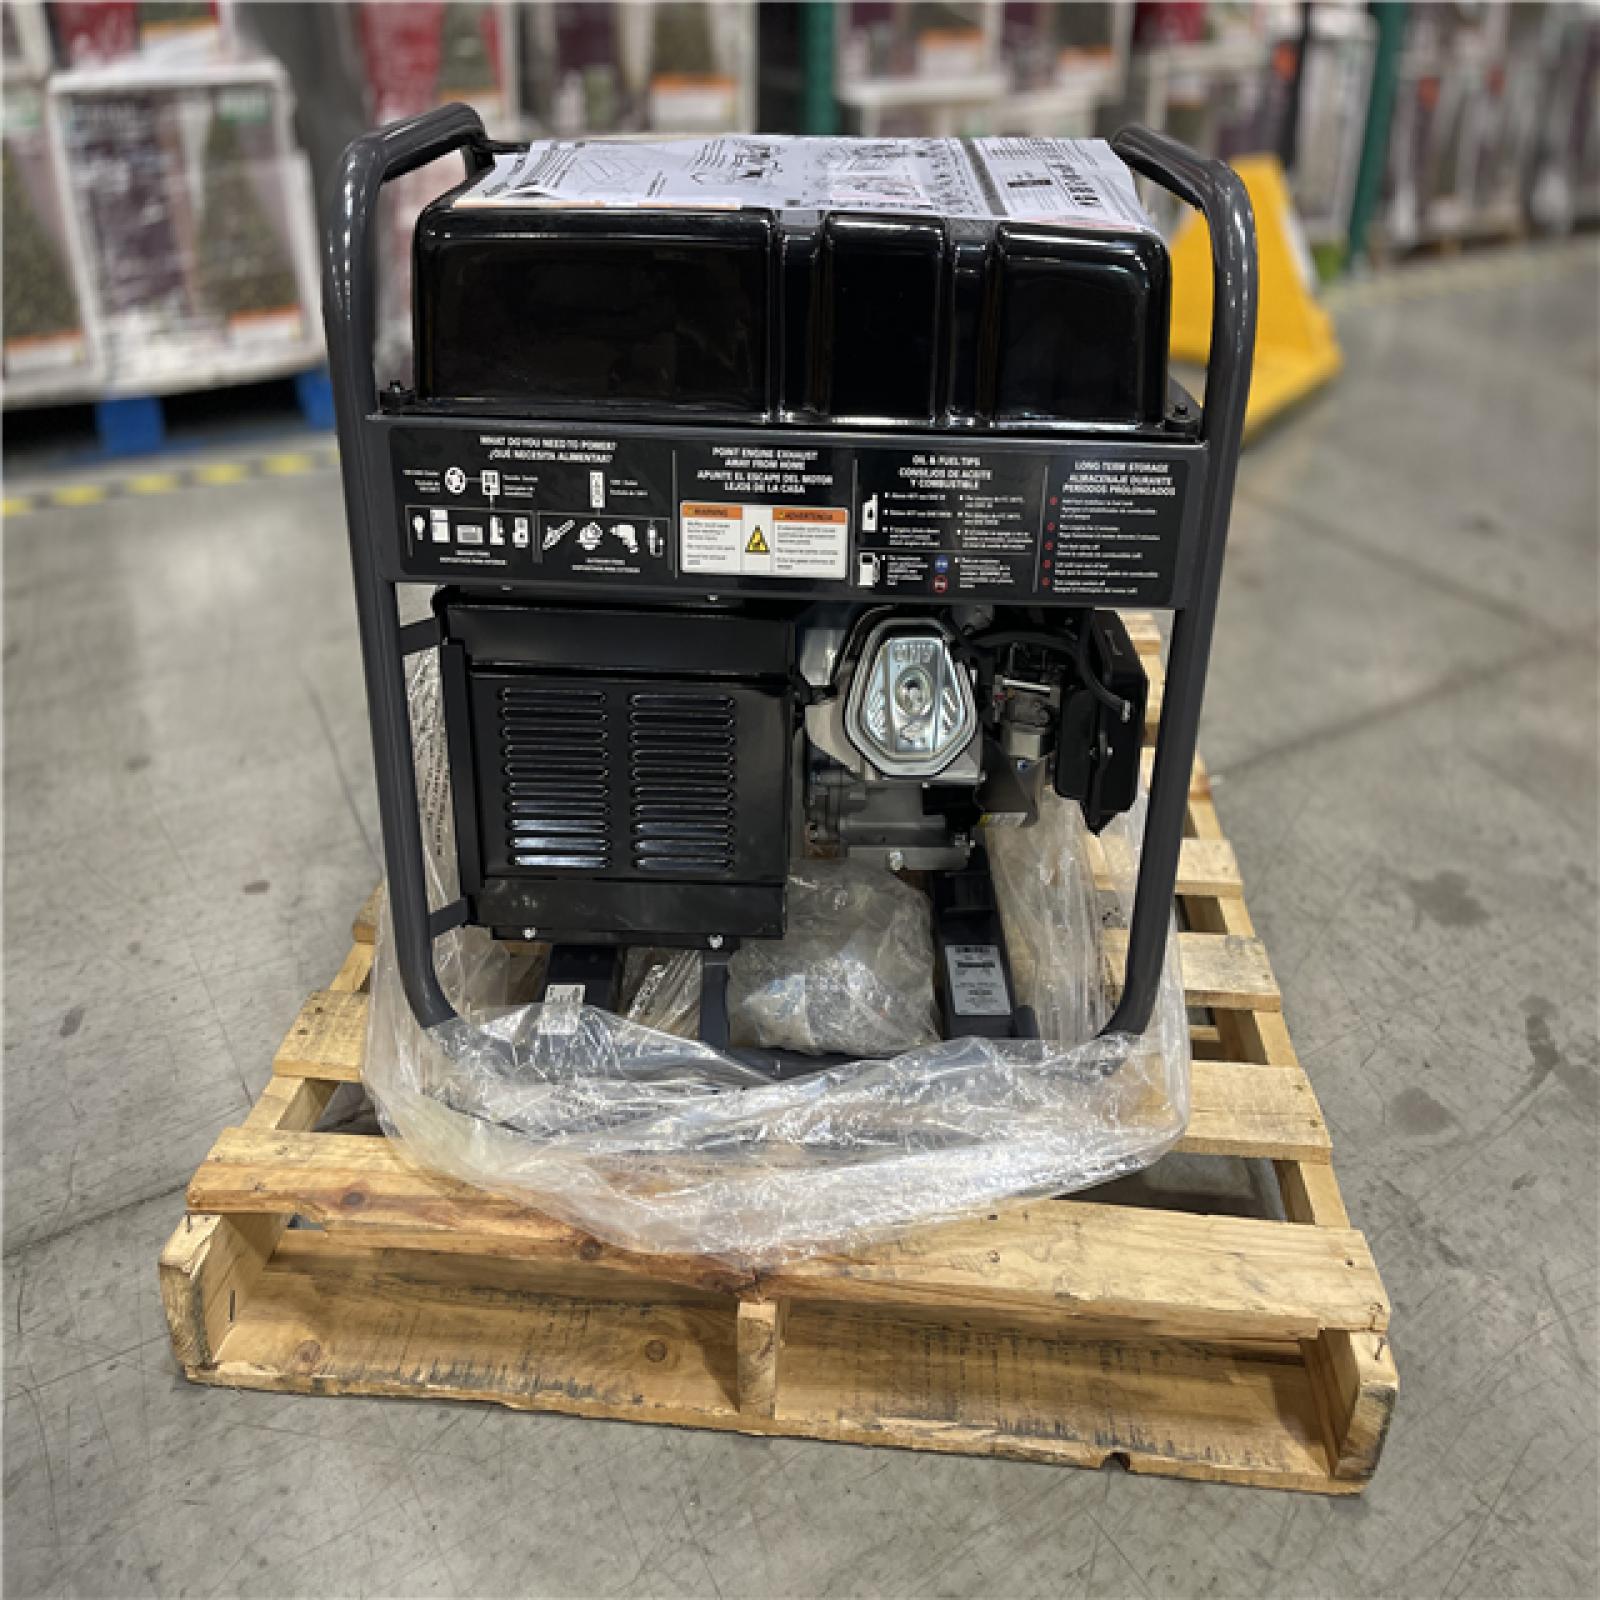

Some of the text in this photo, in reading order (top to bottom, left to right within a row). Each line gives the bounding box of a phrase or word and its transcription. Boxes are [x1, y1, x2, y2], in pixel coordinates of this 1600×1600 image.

[712, 447, 818, 461] POINT ENGINE EXHAUST
[725, 459, 751, 469] AWAY
[752, 459, 778, 470] FROM
[912, 454, 926, 465] OIL
[939, 456, 960, 466] FUEL
[961, 456, 980, 467] TIPS
[1074, 461, 1101, 471] LONG
[1102, 461, 1126, 471] TERM
[735, 472, 745, 481] EL
[747, 472, 781, 482] ESCAPE
[782, 474, 800, 483] DEL
[725, 481, 751, 491] LEJOS
[767, 484, 778, 493] LA
